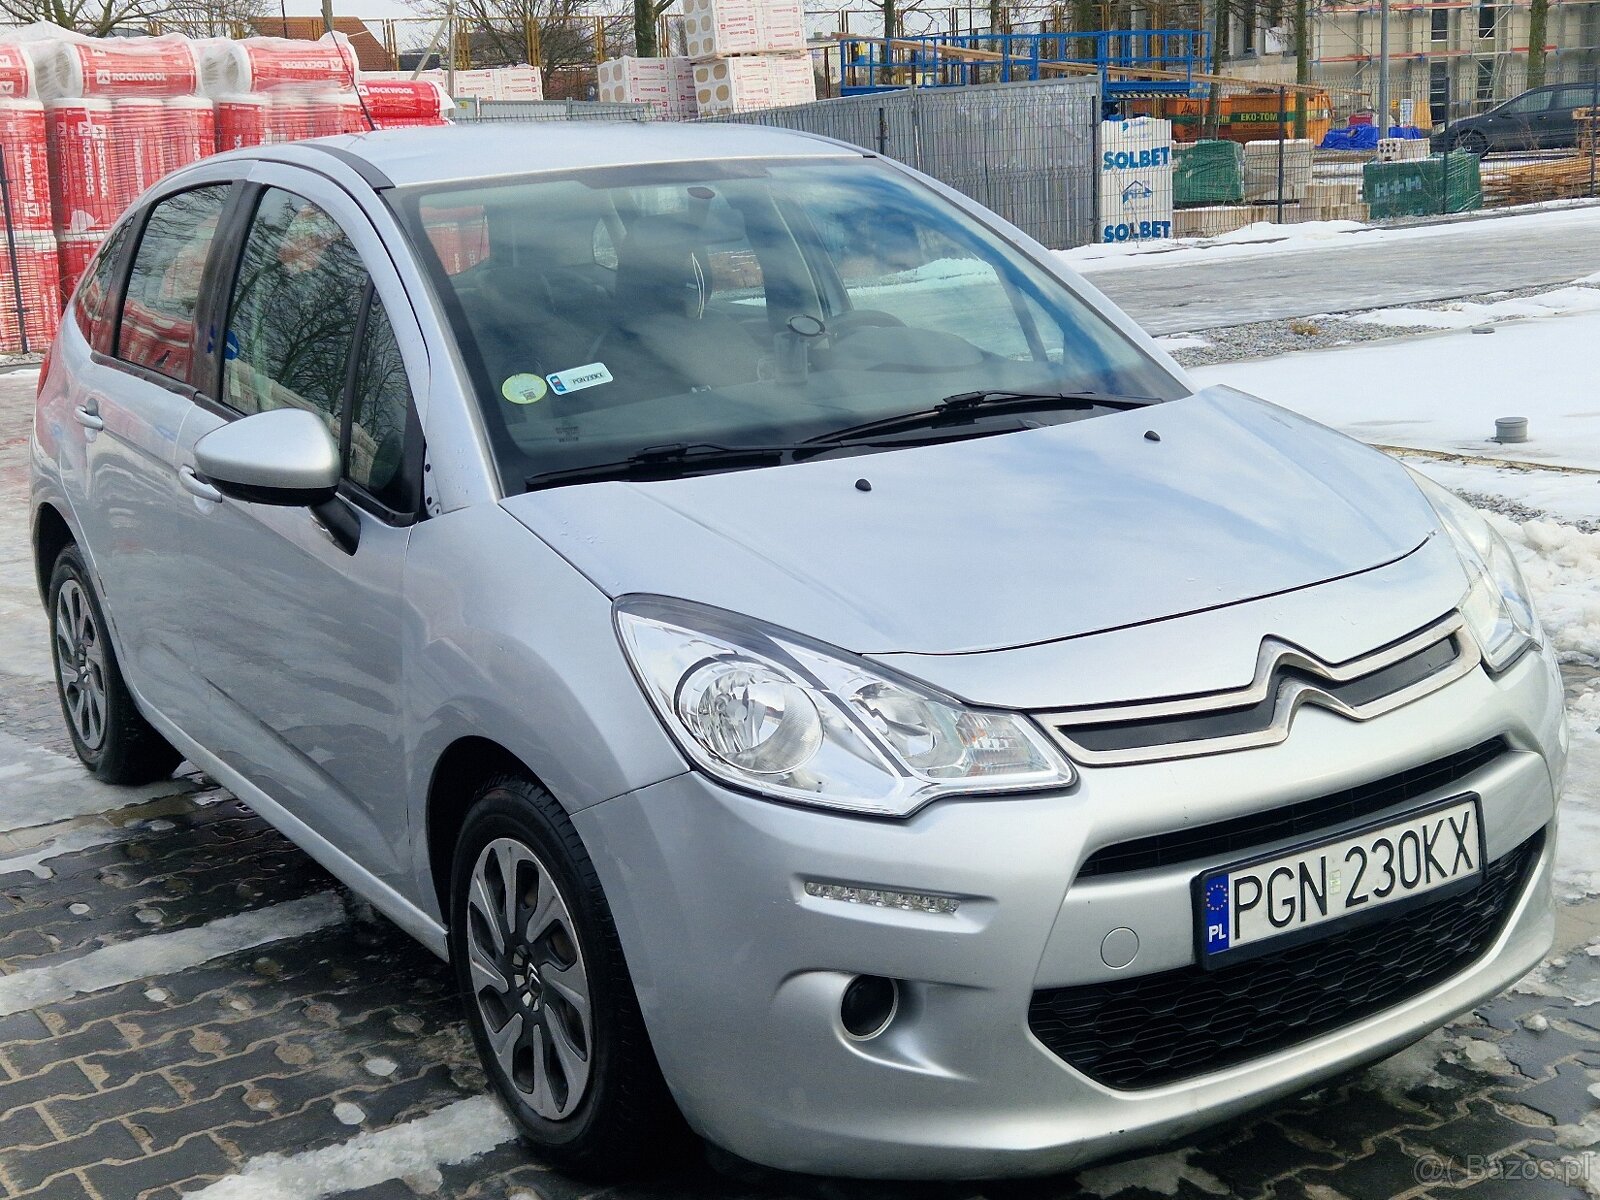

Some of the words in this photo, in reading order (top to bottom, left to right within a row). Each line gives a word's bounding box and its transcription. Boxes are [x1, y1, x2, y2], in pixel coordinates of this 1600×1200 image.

[112, 72, 167, 81] ROCKWOOL
[1240, 112, 1278, 121] EKO-TOM
[82, 137, 95, 198] ROCKWOOL
[97, 139, 109, 198] ROCKWOOL
[1103, 146, 1170, 170] SOLBET
[22, 143, 36, 201] ROCKWOOL
[1103, 220, 1171, 243] SOLBET
[1234, 856, 1328, 940] PGN
[1344, 811, 1474, 908] 230KX
[1208, 923, 1227, 943] PL
